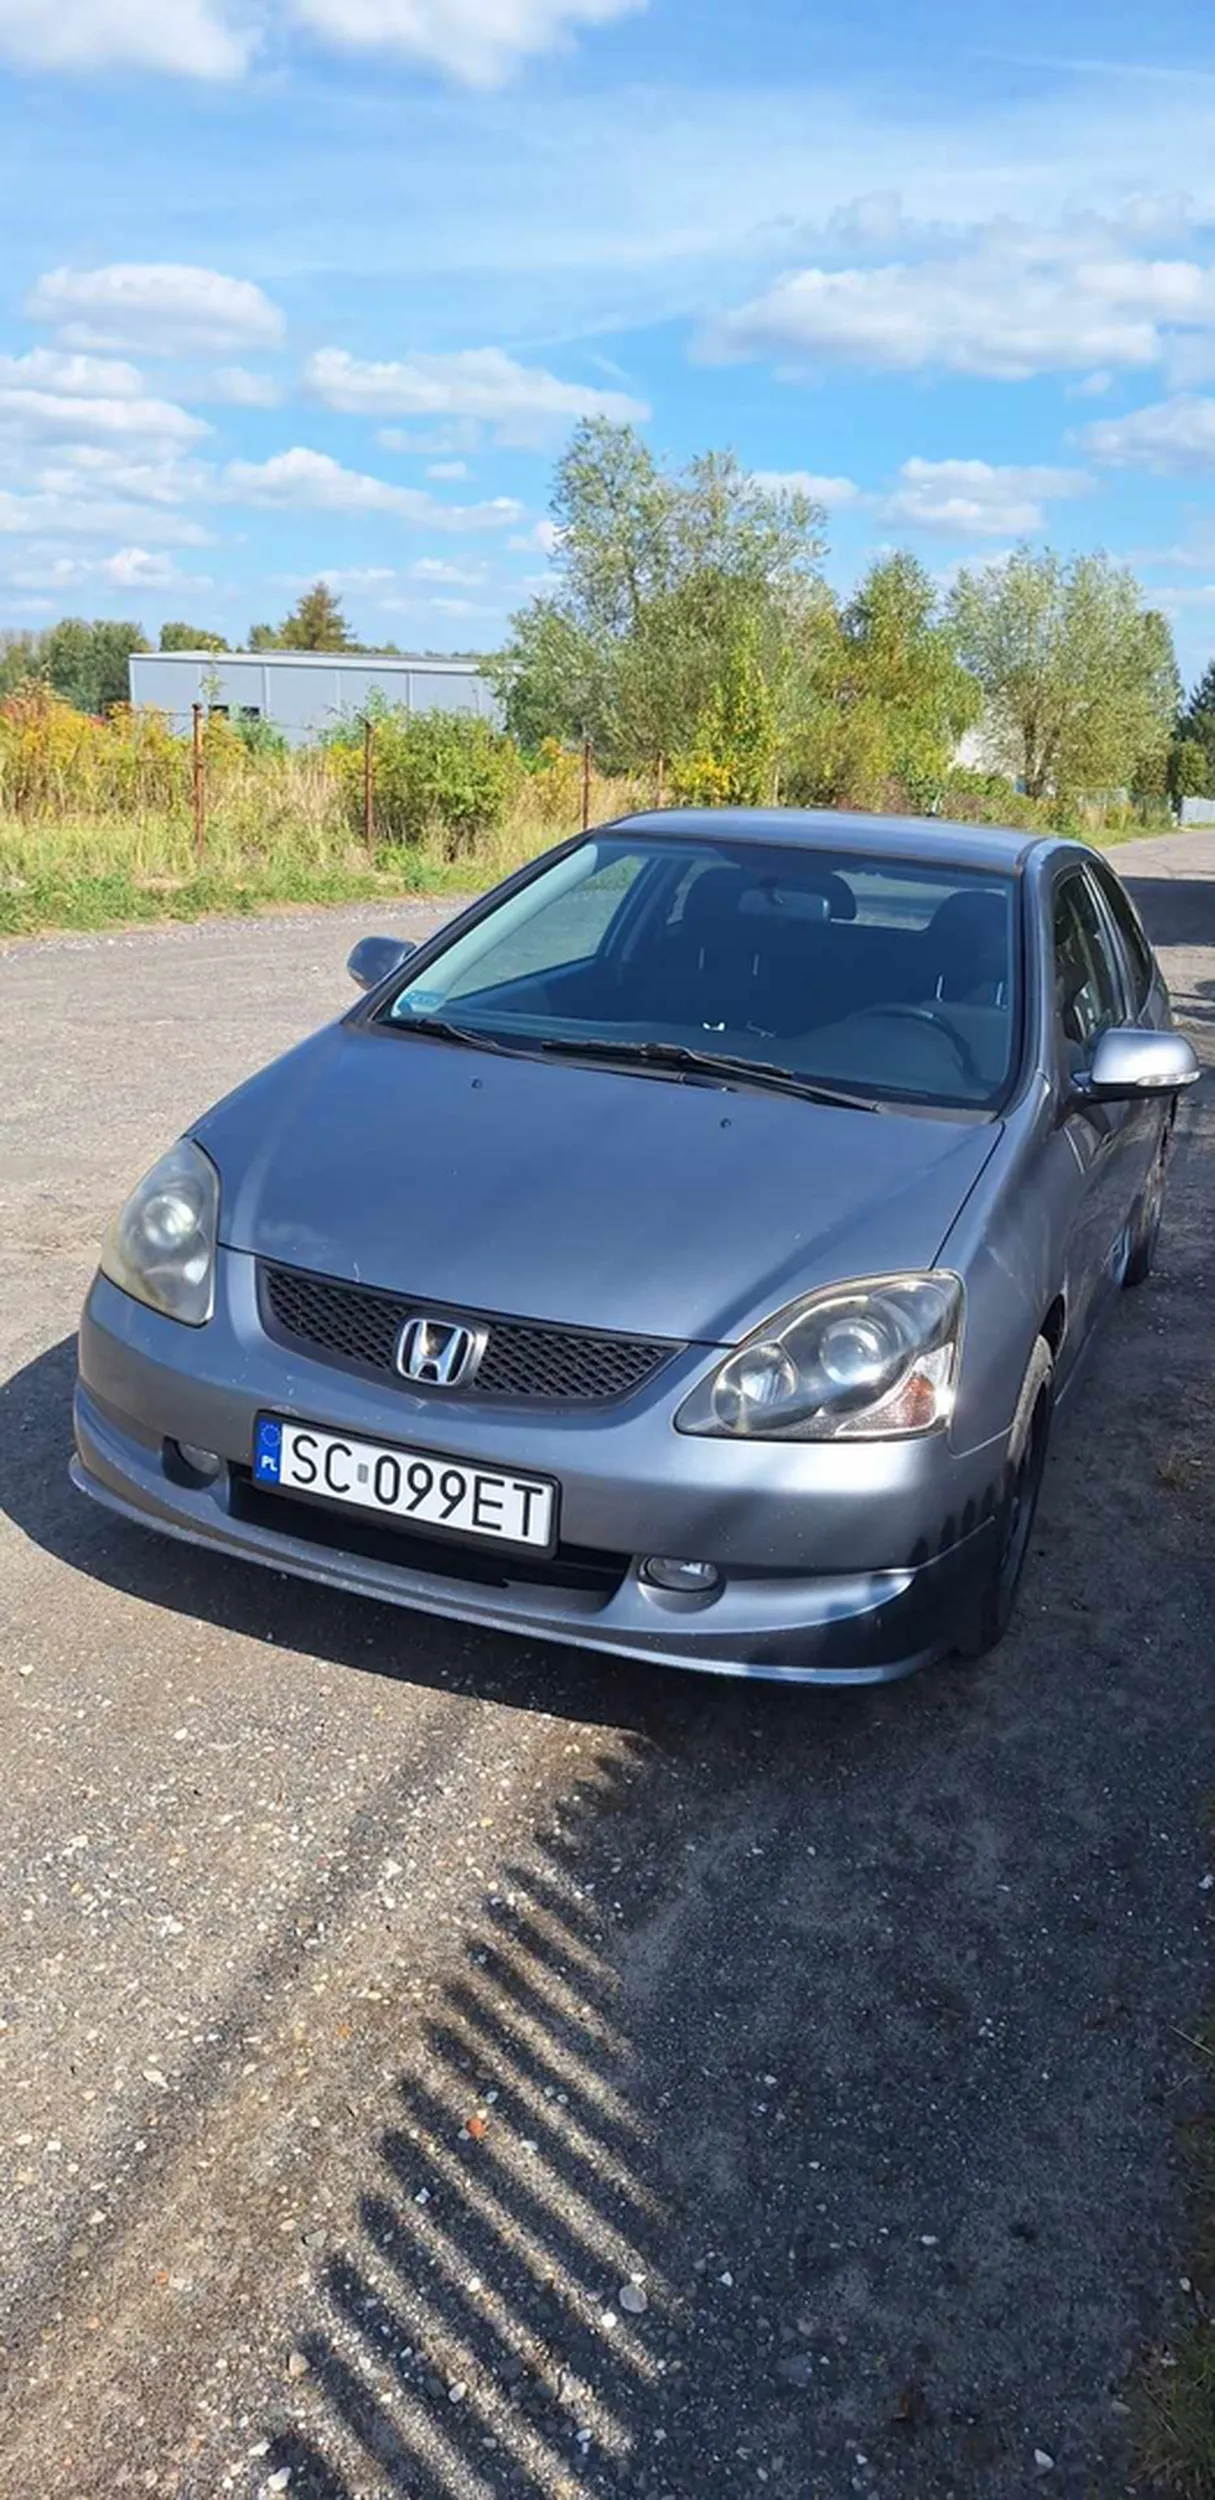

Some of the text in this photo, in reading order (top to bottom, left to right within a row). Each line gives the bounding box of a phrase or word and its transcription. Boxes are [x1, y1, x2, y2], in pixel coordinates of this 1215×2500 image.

[261, 1455, 278, 1472] PL
[291, 1434, 544, 1537] SC 099ET
